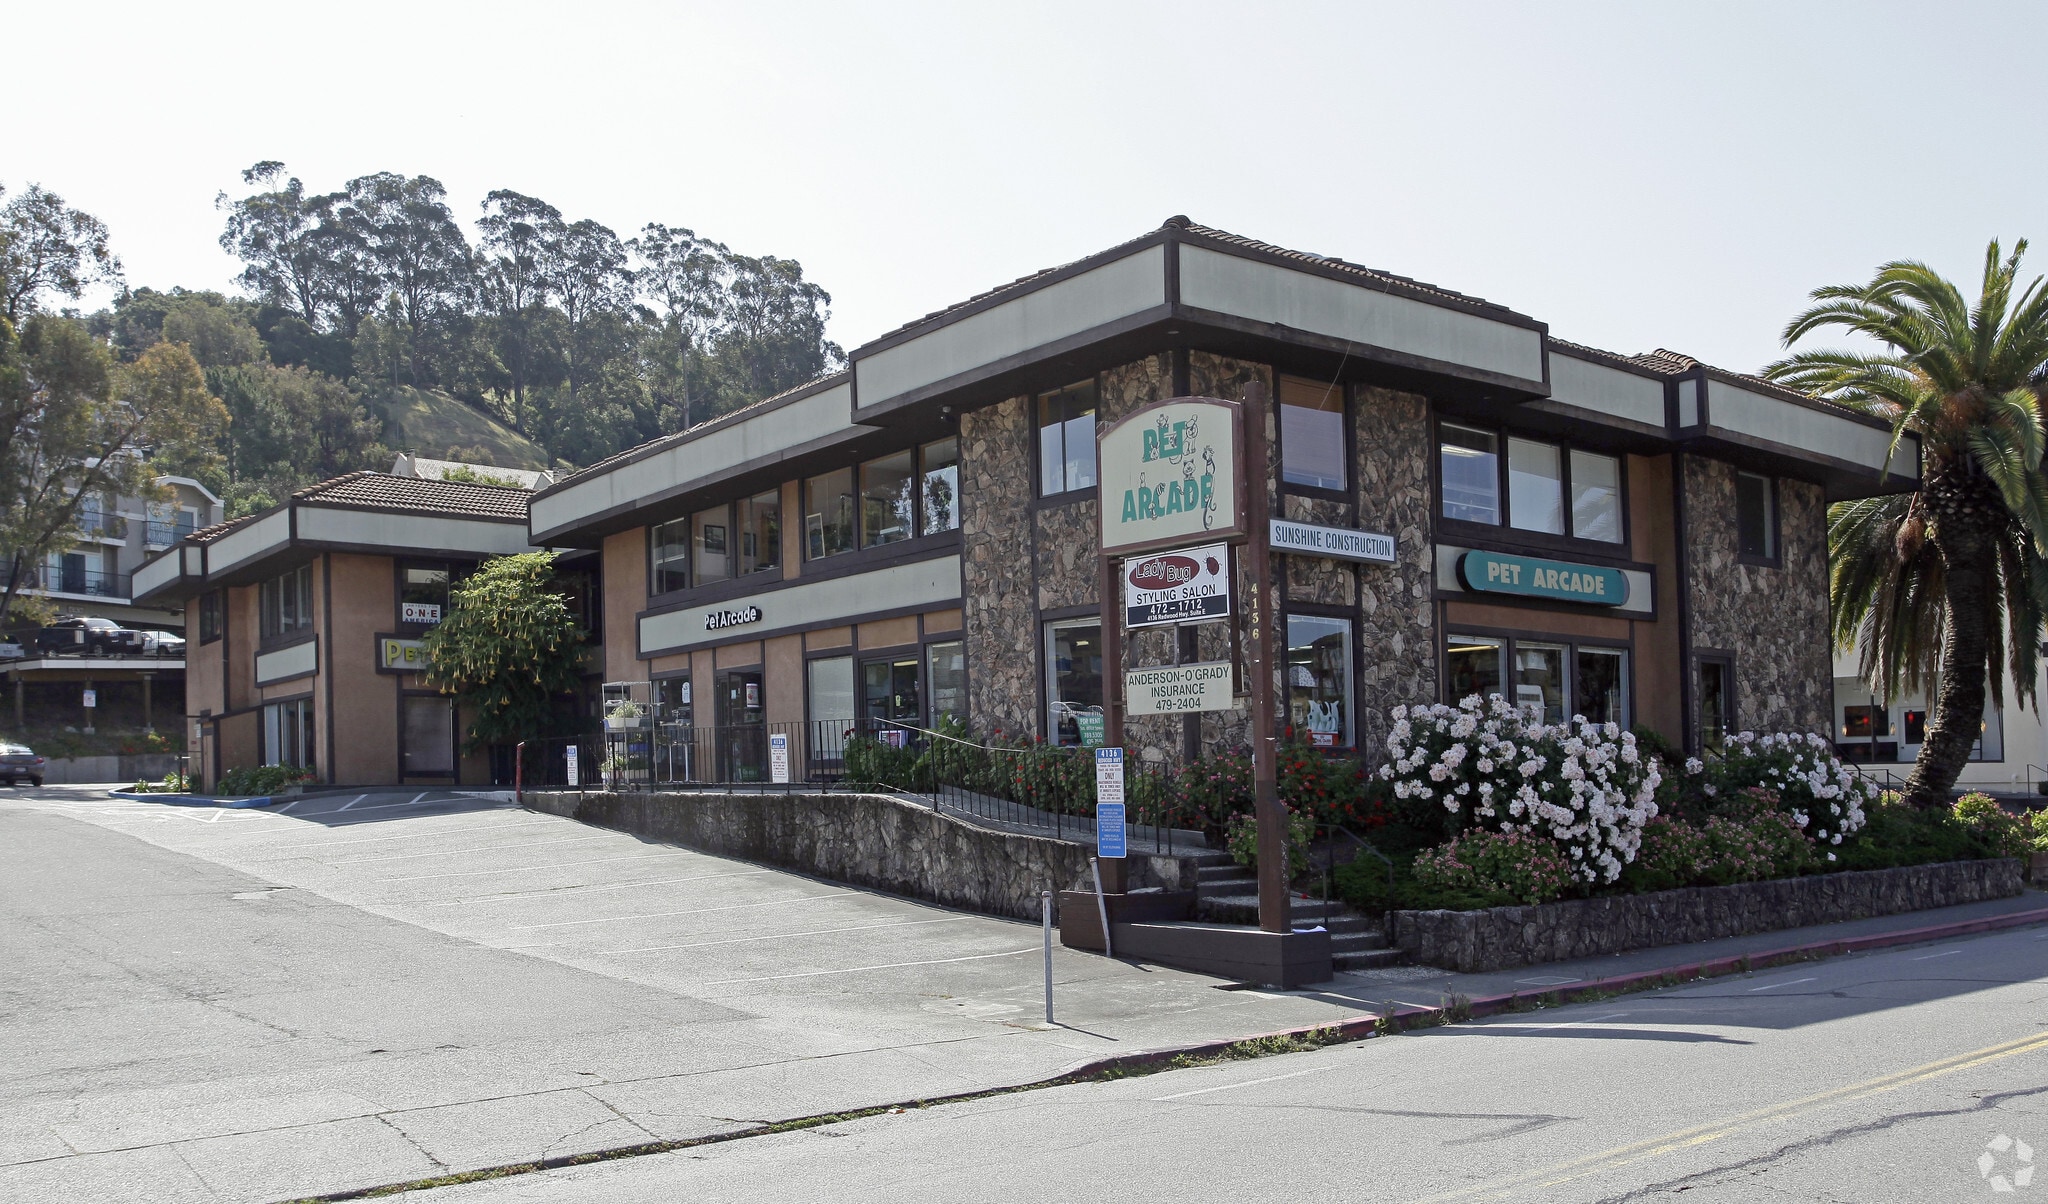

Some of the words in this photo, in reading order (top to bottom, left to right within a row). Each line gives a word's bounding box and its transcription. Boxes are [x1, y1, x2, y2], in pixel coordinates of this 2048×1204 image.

[1142, 421, 1186, 463] PET
[1121, 473, 1213, 523] ARCADE
[1275, 525, 1321, 547] SUNSHINE
[1325, 532, 1390, 556] CONSTRUCTION
[1135, 558, 1166, 579] Lady
[1167, 565, 1191, 583] Bug
[1487, 561, 1520, 584] PET
[1533, 567, 1605, 595] ARCADE
[1136, 589, 1176, 605] STYLING
[1182, 584, 1216, 599] SALON
[1158, 612, 1178, 620] Redwood
[1250, 583, 1259, 639] 4136
[1128, 666, 1230, 686] ANDERSON-O'GRADY
[1151, 683, 1205, 698] INSURANCE
[1156, 697, 1202, 711] 479-2404
[1101, 749, 1118, 757] 4136
